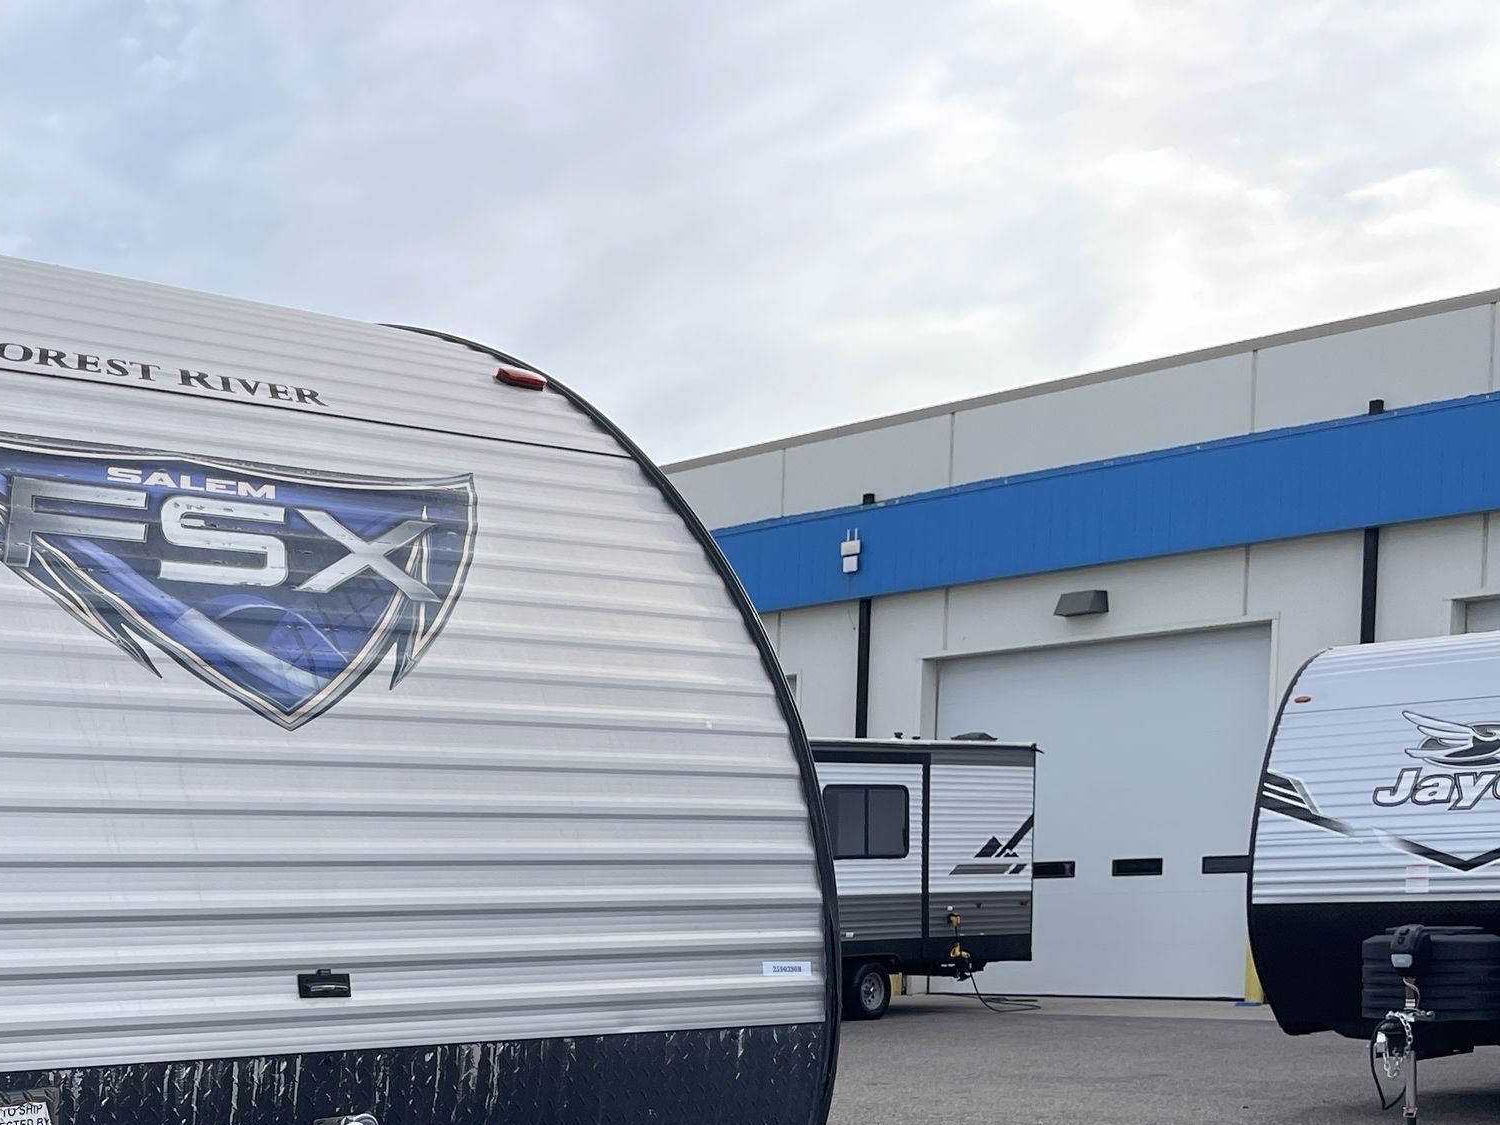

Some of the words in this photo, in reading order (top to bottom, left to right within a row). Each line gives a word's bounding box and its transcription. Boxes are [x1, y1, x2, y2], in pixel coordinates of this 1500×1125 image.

[178, 368, 329, 407] RIVER
[107, 467, 276, 499] SALEM
[3, 475, 442, 603] FSX
[19, 1104, 43, 1116] SHIP
